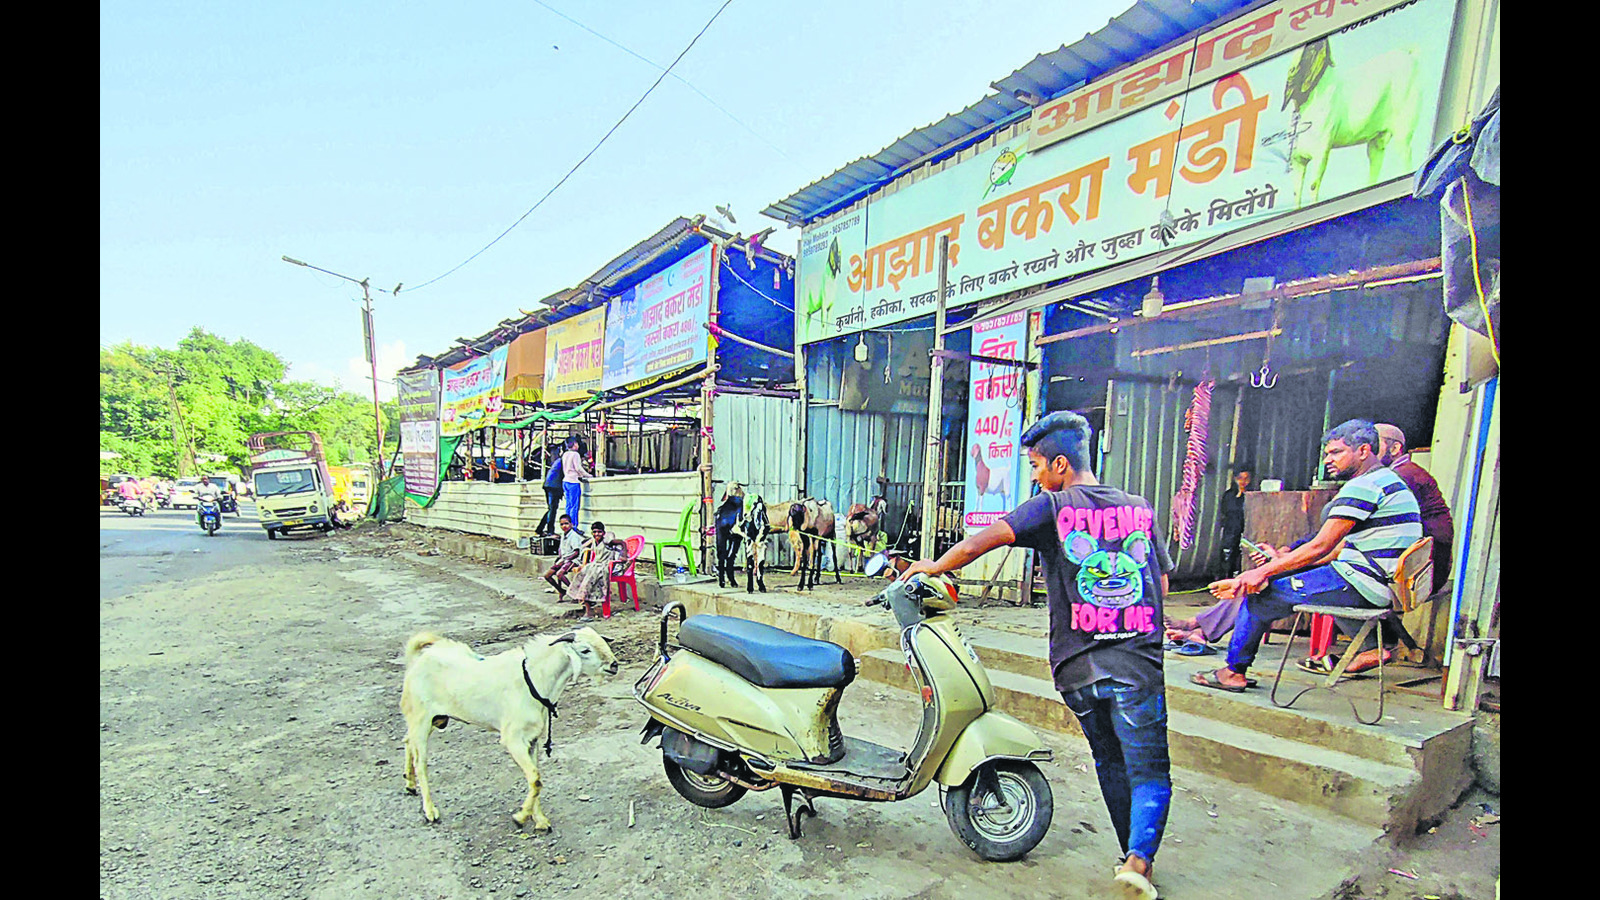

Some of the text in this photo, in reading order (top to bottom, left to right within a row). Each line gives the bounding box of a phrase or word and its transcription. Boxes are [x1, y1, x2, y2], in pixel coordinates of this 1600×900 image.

[1037, 8, 1283, 136] आझाद
[847, 72, 1269, 293] आझाद बकरा मंडी
[959, 275, 985, 295] लिए
[988, 260, 1019, 286] बकरे
[1023, 248, 1060, 276] रखने
[1065, 239, 1096, 264] और
[1207, 183, 1278, 226] मिलेंगे
[974, 372, 1019, 402] बकरा
[988, 441, 1013, 459] किलो
[1071, 602, 1155, 633] FOR ME
